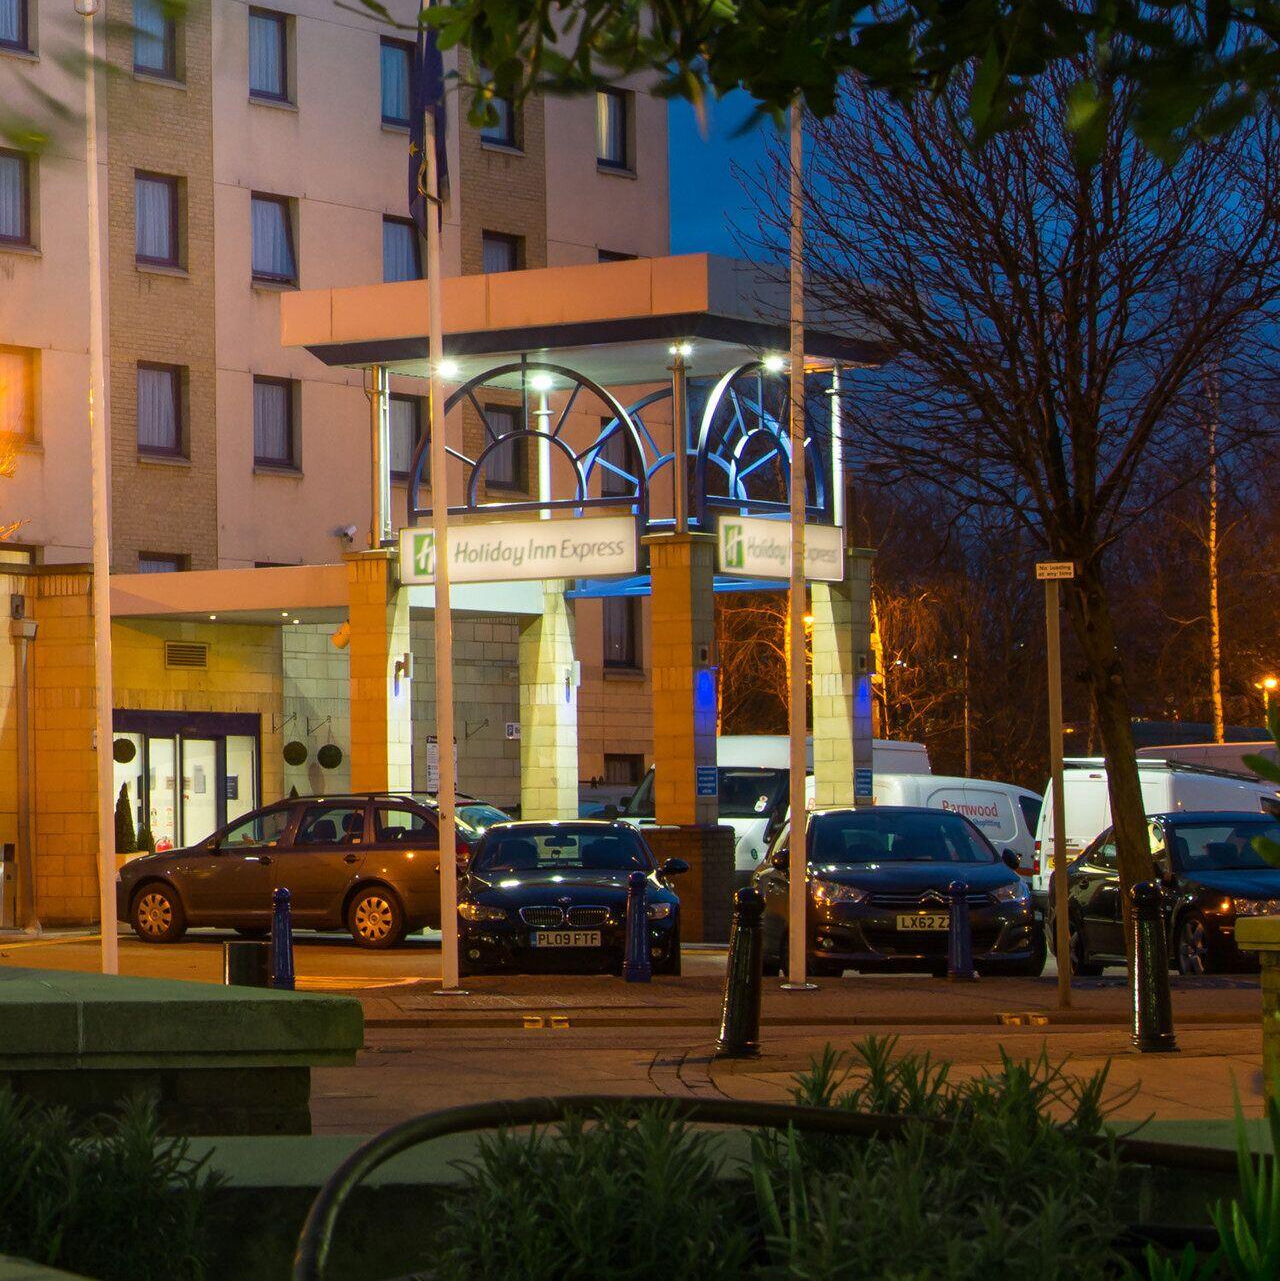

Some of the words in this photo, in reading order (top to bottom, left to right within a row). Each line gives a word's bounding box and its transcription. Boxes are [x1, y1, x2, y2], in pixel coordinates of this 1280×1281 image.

[454, 540, 525, 566] Holiday
[528, 538, 556, 560] Inn
[560, 539, 625, 562] Express
[901, 917, 935, 928] LX62
[538, 933, 571, 945] PL09
[574, 933, 598, 945] FTF
